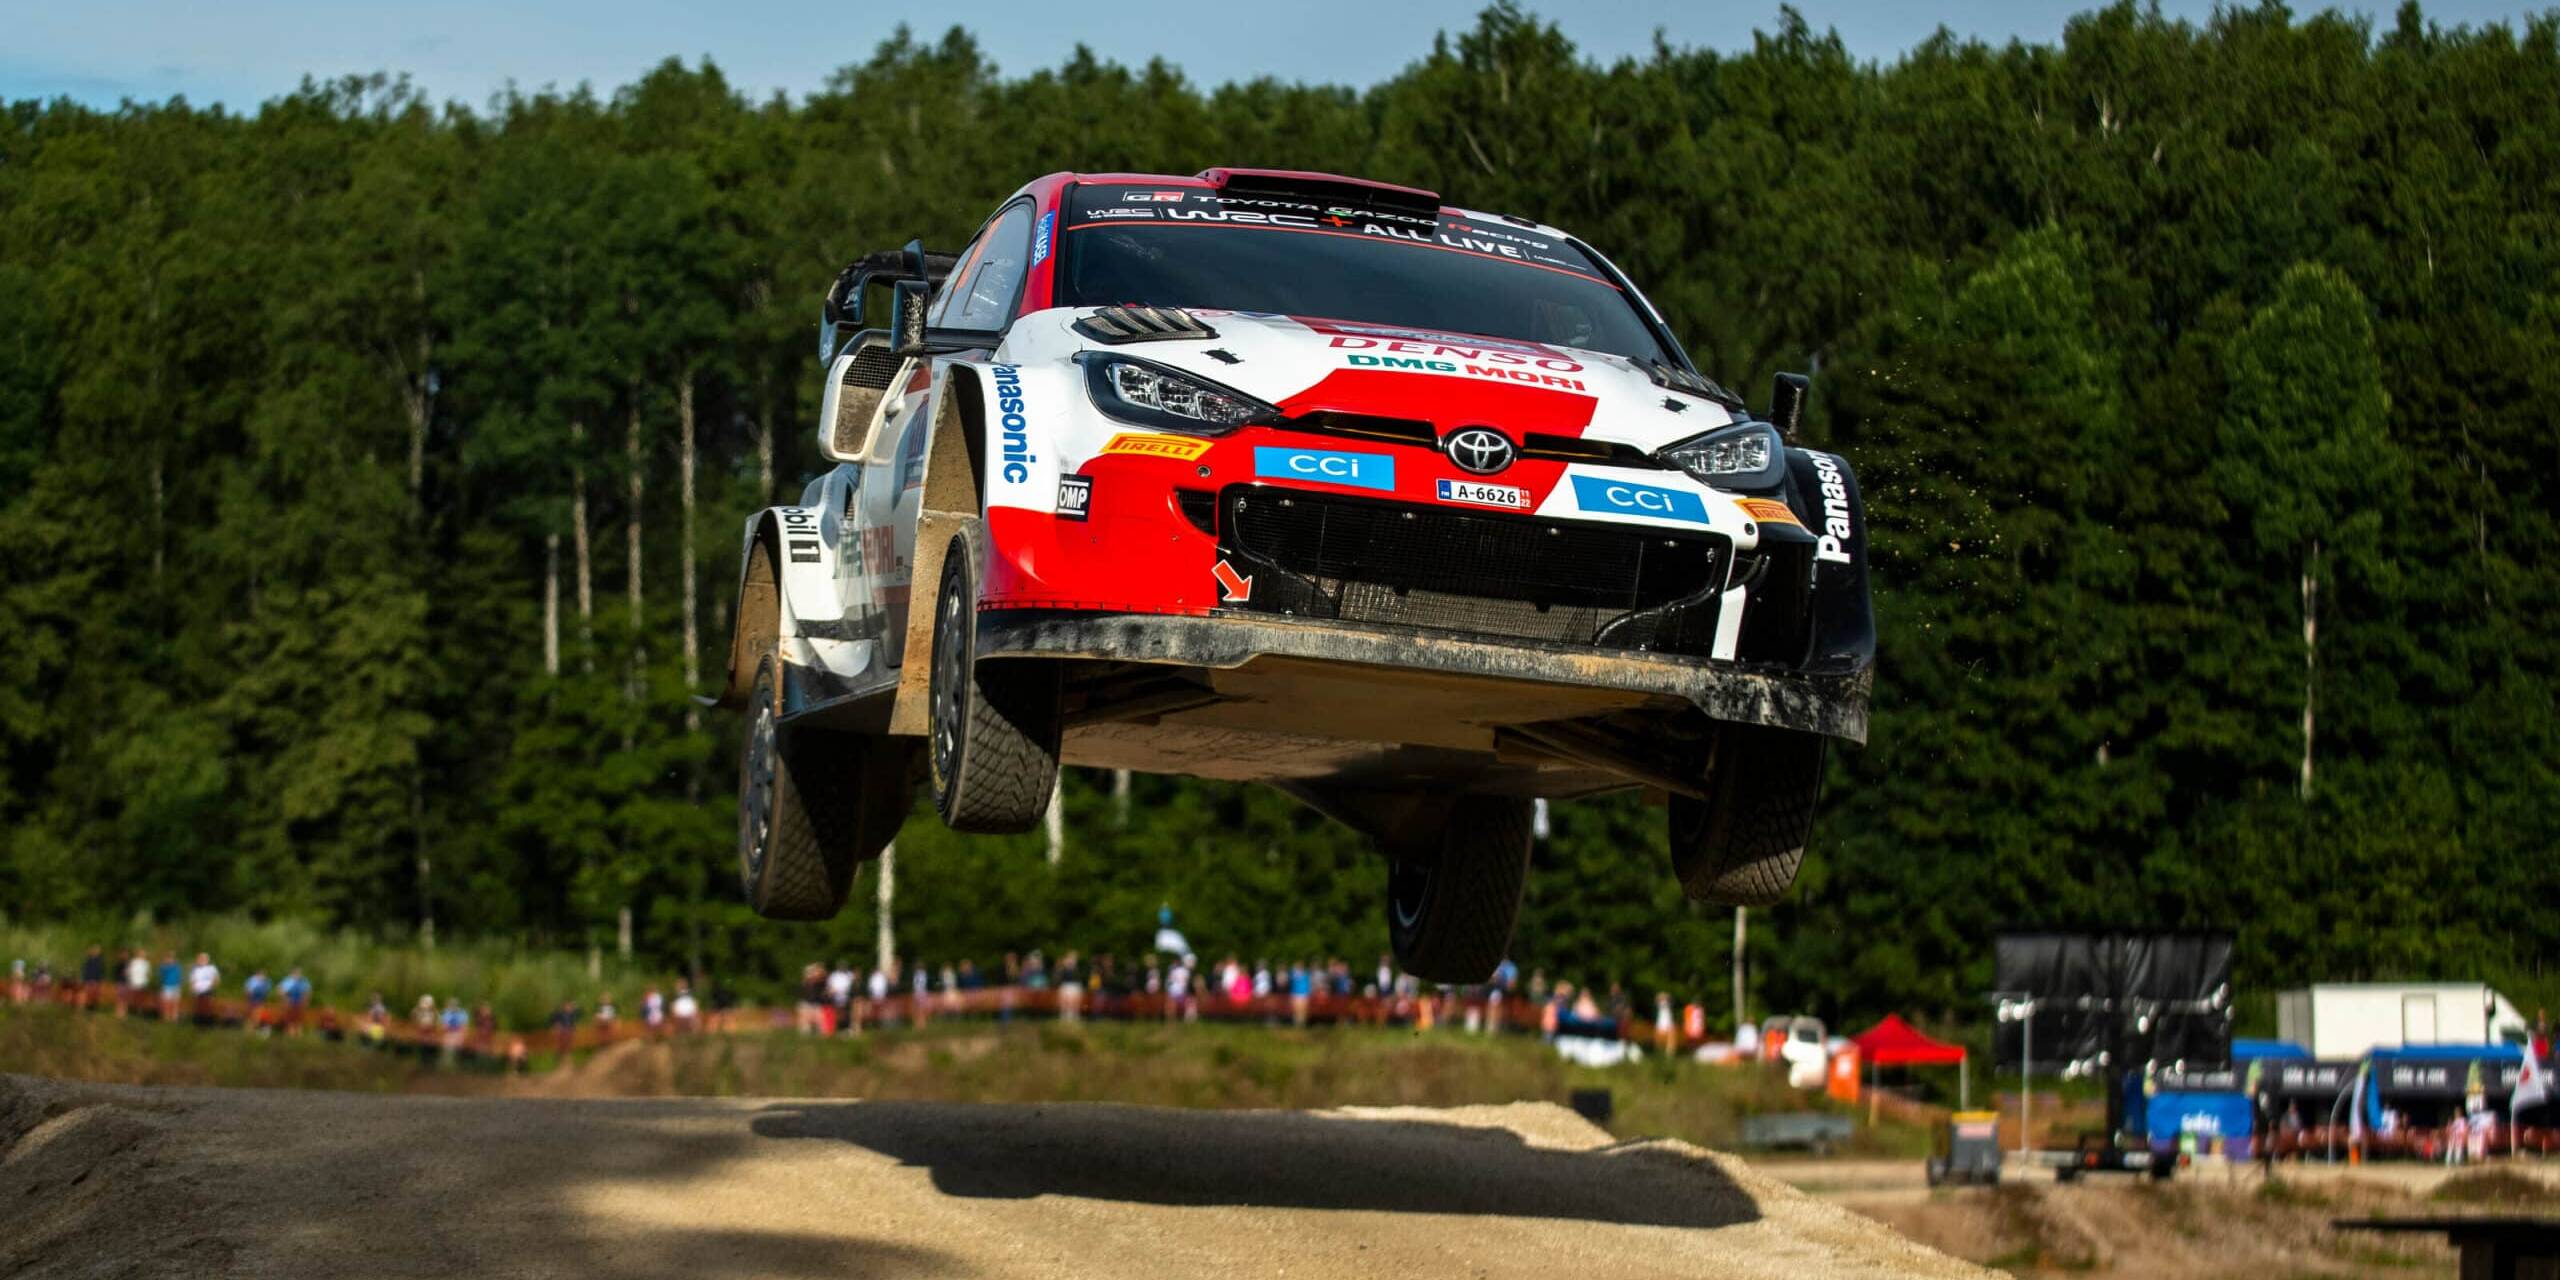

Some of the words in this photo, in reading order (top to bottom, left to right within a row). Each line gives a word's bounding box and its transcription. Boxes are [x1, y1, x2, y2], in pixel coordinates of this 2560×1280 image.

[1087, 208, 1153, 216] WRC
[1363, 223, 1432, 242] ALL
[1440, 234, 1521, 258] LIVE
[1193, 195, 1319, 211] TOYOTA
[1328, 206, 1439, 226] GAZOO
[1448, 223, 1549, 250] Racing
[1328, 336, 1585, 373] DENSO
[1346, 354, 1457, 372] DMG
[1465, 364, 1586, 391] MORI
[1109, 436, 1202, 456] PIRELLI
[1289, 454, 1359, 478] CCi
[1059, 486, 1088, 509] OMP
[1458, 485, 1516, 504] A-6626
[1520, 490, 1529, 498] 11
[1520, 499, 1531, 508] 22
[1605, 486, 1674, 512] CCi
[781, 508, 818, 535] obil
